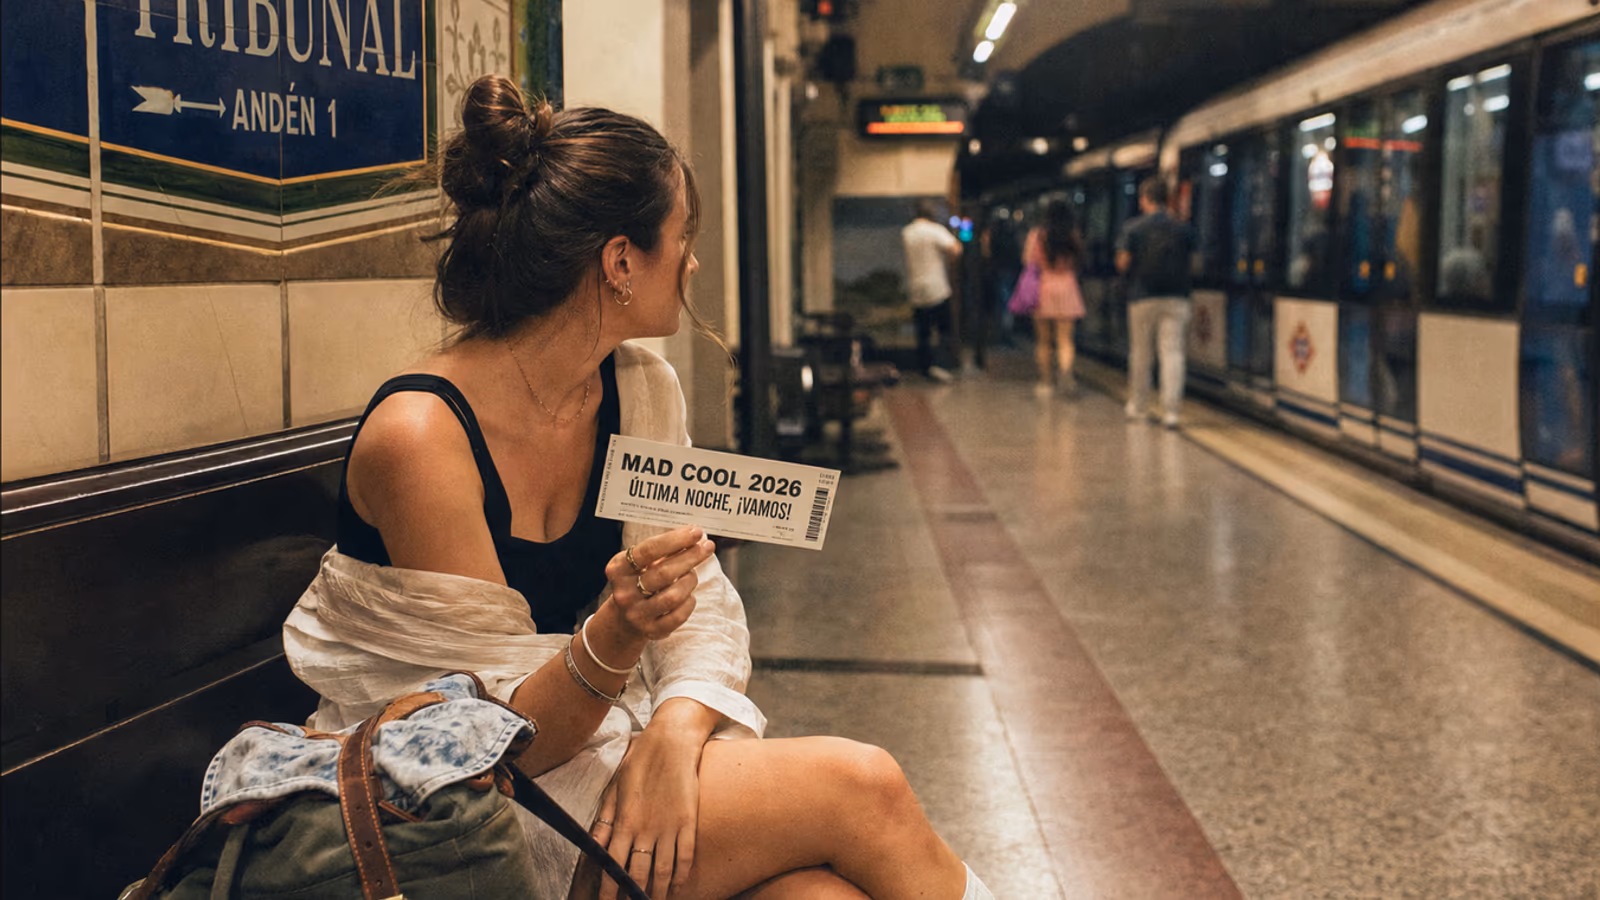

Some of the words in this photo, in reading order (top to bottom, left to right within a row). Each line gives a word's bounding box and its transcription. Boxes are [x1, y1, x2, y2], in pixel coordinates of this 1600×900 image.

[232, 82, 315, 136] ANDÉN
[327, 99, 337, 138] 1
[621, 453, 673, 477] MAD
[680, 463, 741, 489] COOL
[748, 474, 802, 497] 2026
[629, 476, 679, 504] ÚLTIMA
[685, 486, 732, 515] NOCHE,
[736, 496, 792, 521] ¡VAMOS!
